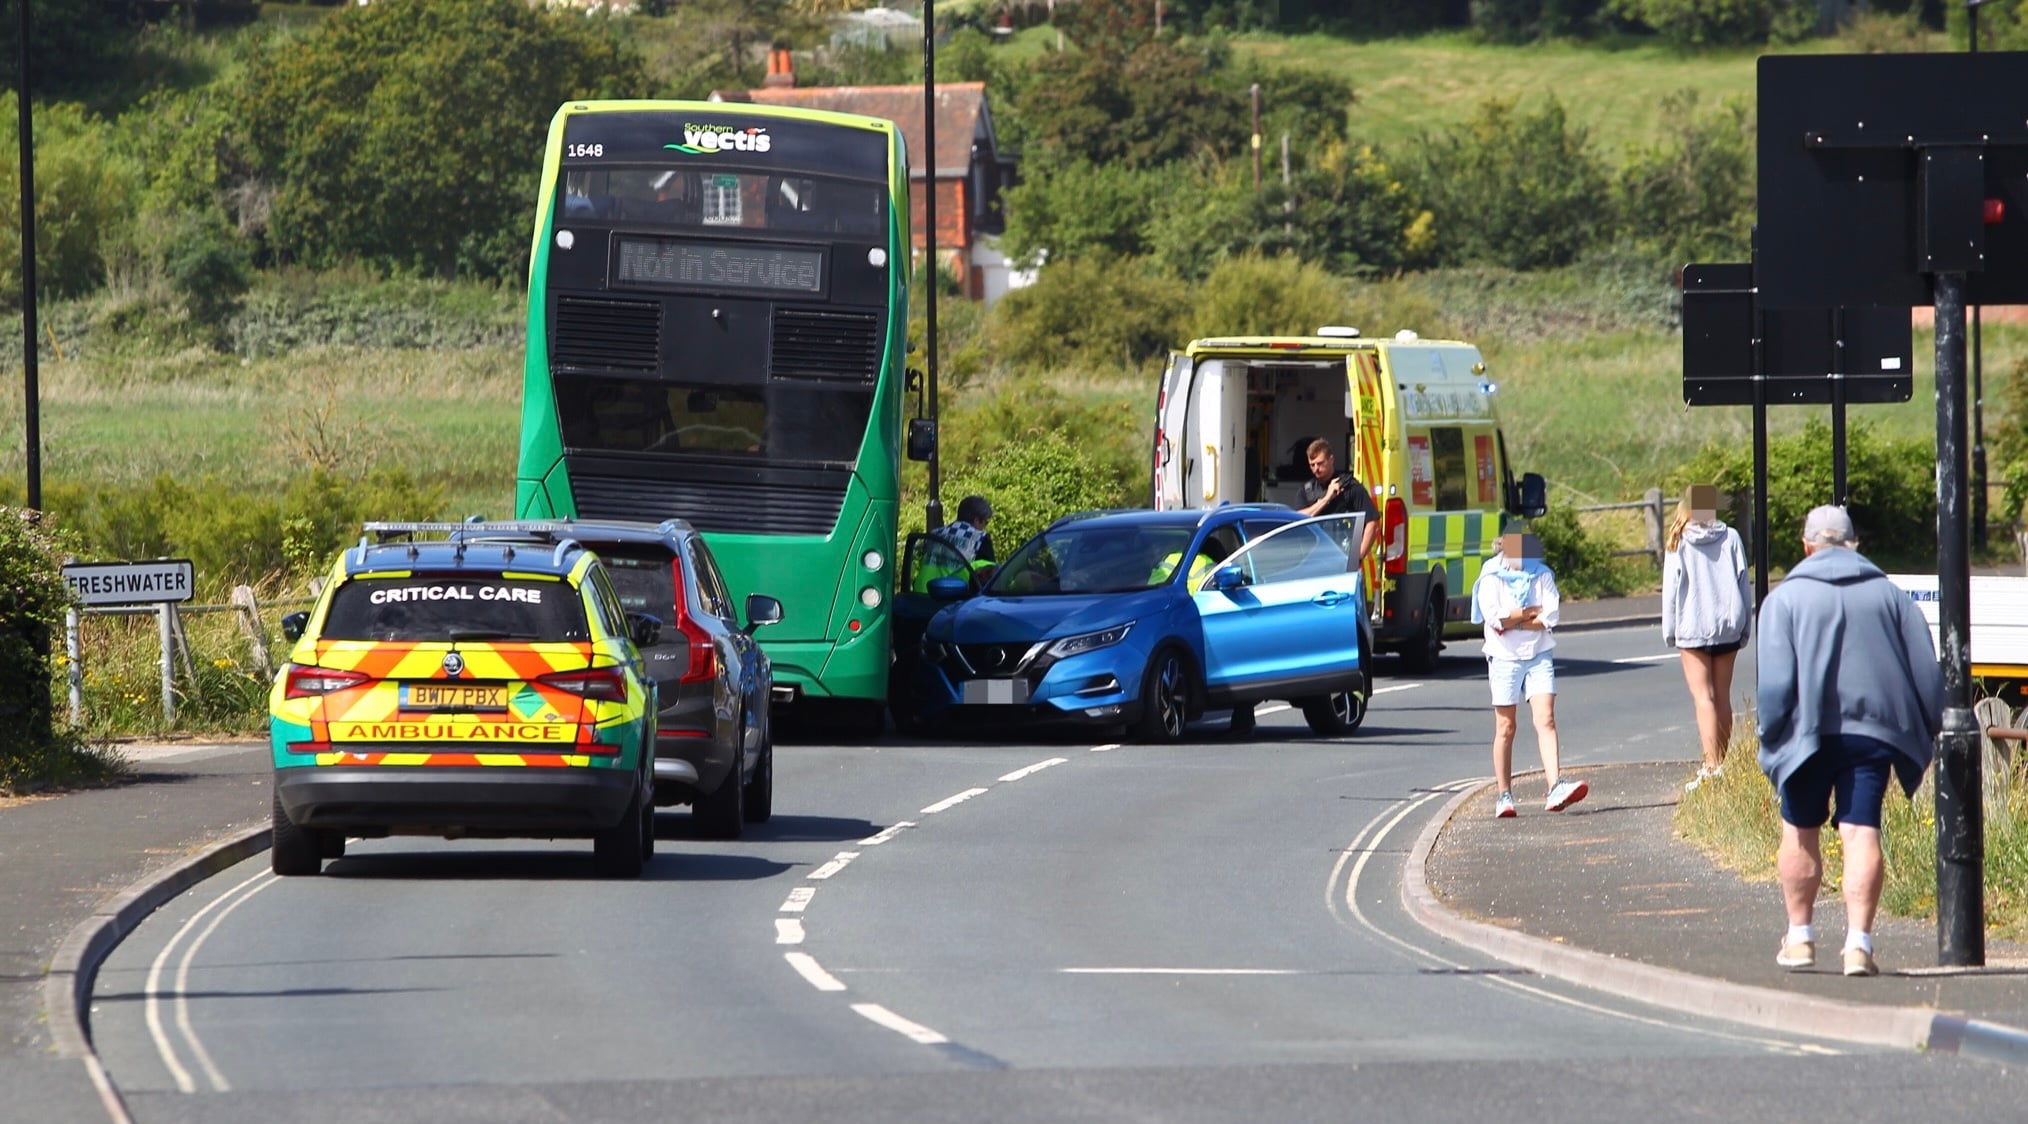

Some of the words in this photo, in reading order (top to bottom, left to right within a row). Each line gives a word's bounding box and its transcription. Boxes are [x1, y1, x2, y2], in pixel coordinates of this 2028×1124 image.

[684, 123, 733, 133] Southern
[684, 128, 771, 152] vectis
[568, 143, 603, 157] 1648
[622, 244, 673, 279] Not
[680, 248, 703, 281] in
[709, 250, 815, 287] Service
[69, 573, 185, 594] FRESHWATER
[370, 586, 474, 604] CRITICAL
[478, 587, 542, 604] CARE
[416, 687, 458, 704] BW17
[463, 688, 500, 706] PBX
[347, 725, 561, 740] AMBULANCE
